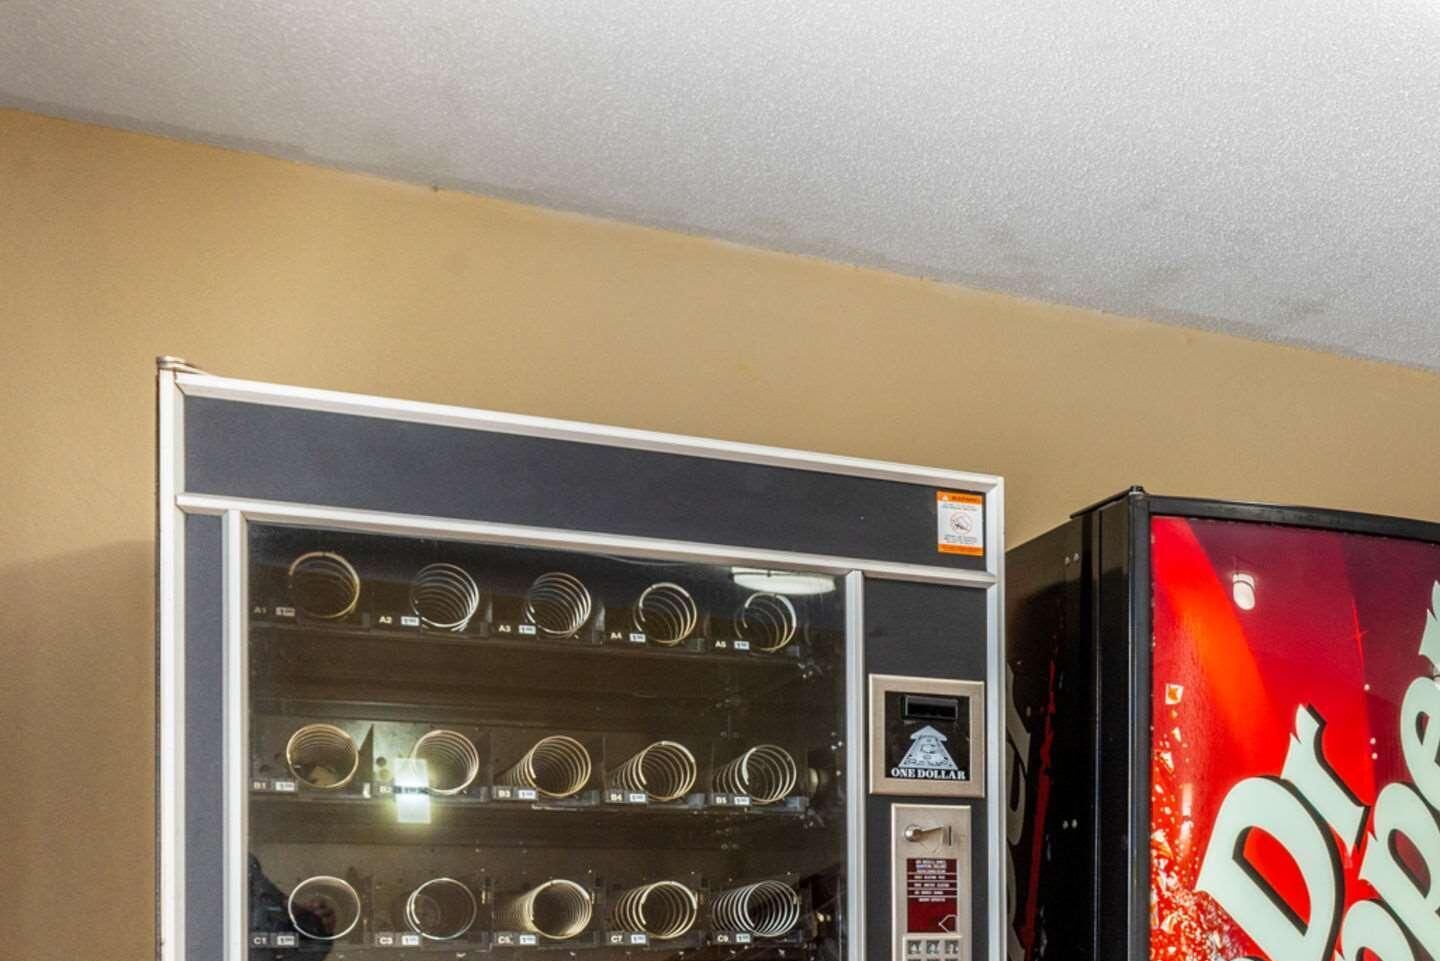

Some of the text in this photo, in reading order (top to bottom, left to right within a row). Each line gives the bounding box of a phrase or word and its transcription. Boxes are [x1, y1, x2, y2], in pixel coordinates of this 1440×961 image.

[379, 615, 392, 624] A2
[498, 624, 511, 632] A3
[611, 631, 622, 639] A4
[891, 767, 966, 780] ONE DOLLAR
[254, 936, 266, 944] C1
[611, 935, 623, 943] C7
